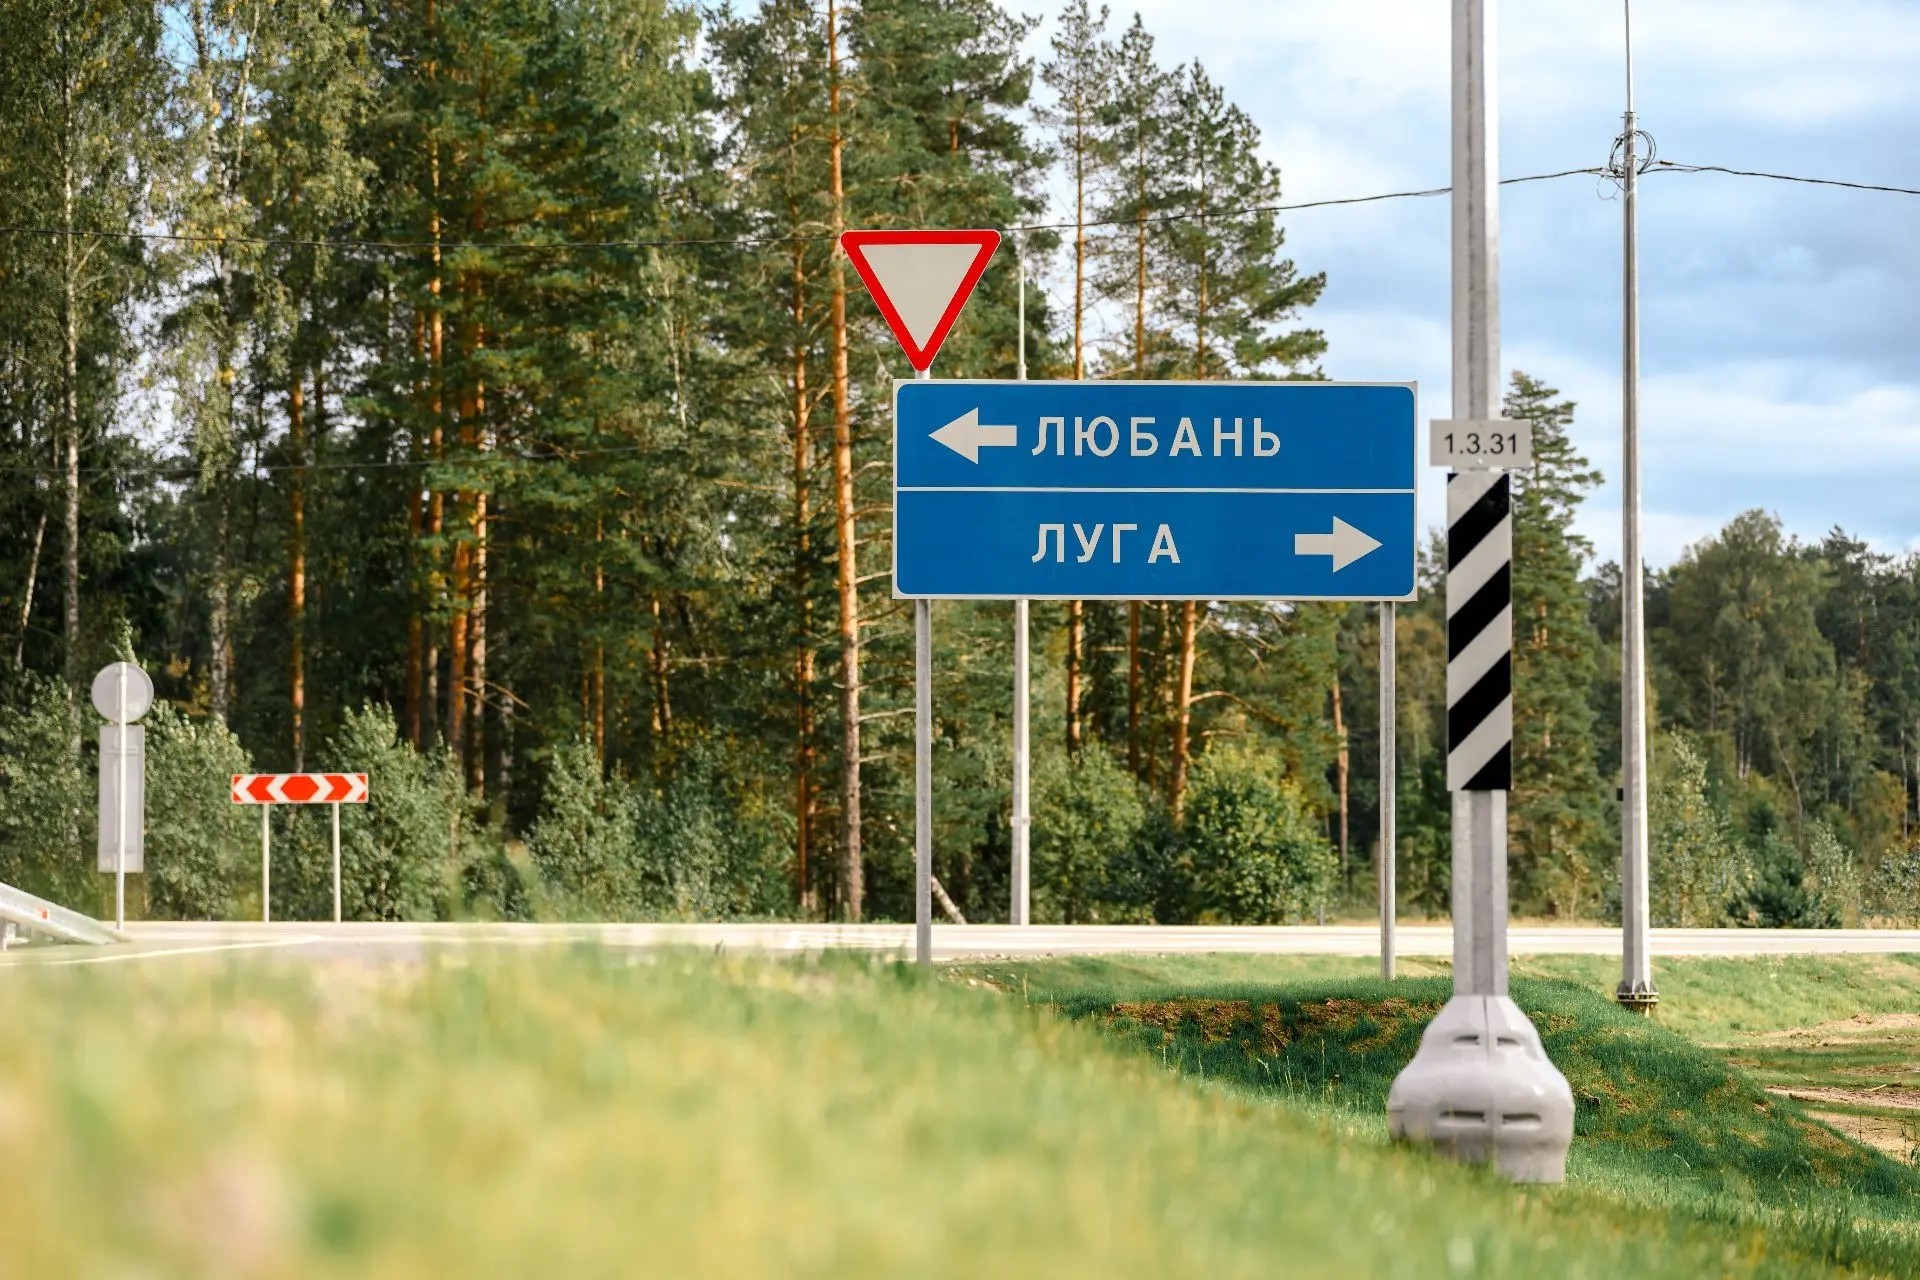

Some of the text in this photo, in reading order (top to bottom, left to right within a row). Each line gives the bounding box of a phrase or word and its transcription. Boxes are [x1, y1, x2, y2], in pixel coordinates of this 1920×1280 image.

[1031, 416, 1281, 457] ЛЮБАНЬ
[1444, 432, 1517, 455] 1.3.31
[1031, 523, 1181, 564] ЛУГА
